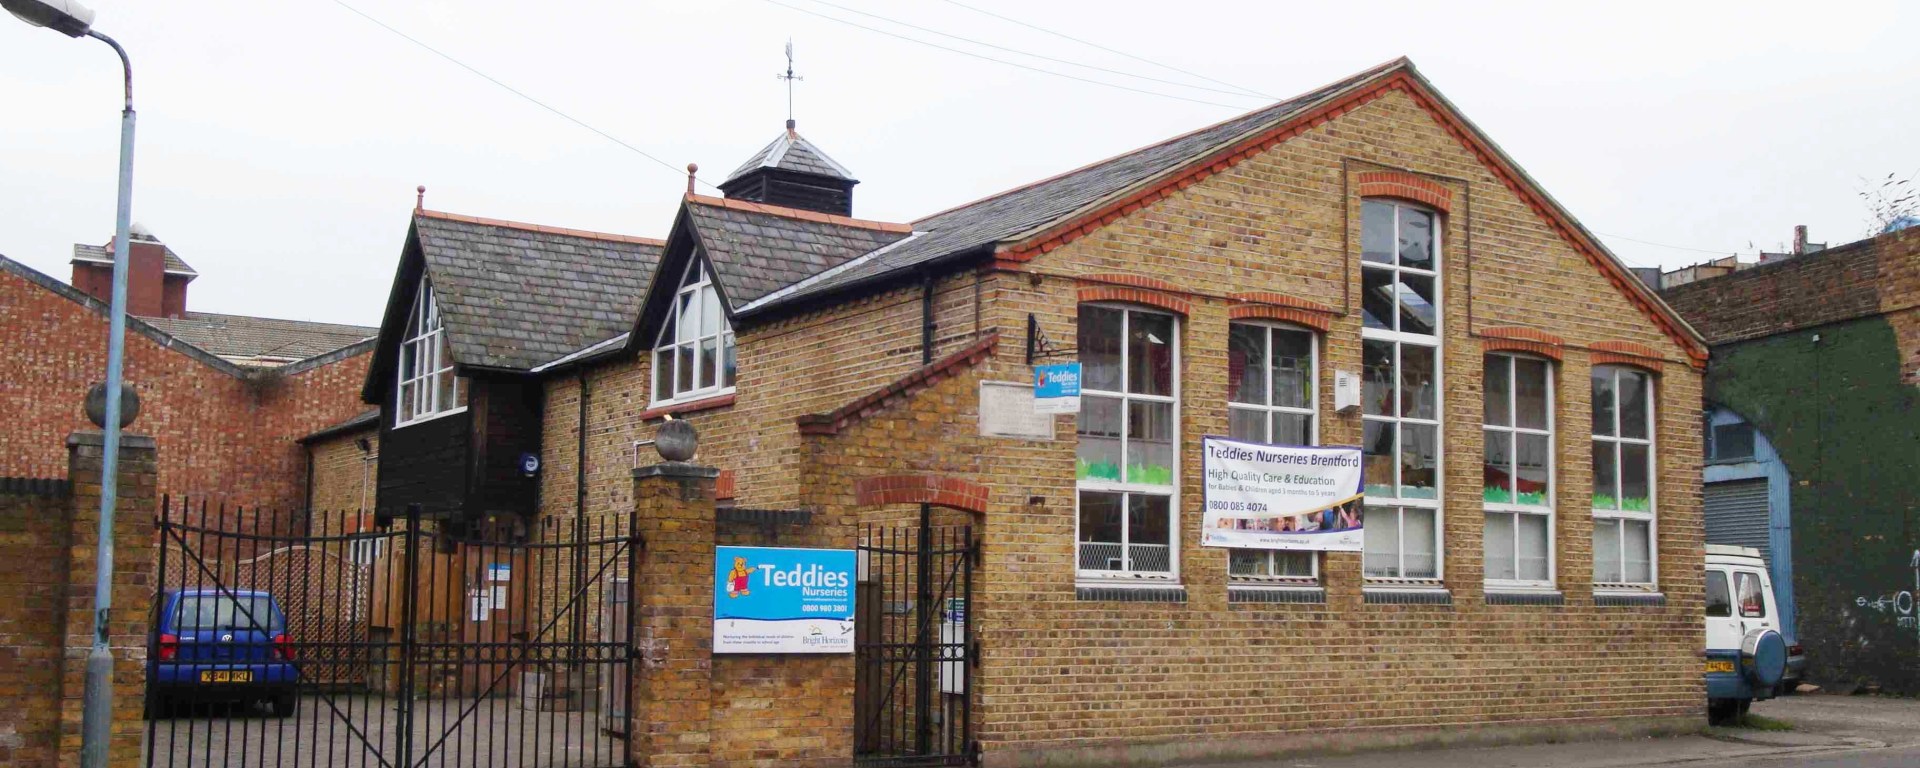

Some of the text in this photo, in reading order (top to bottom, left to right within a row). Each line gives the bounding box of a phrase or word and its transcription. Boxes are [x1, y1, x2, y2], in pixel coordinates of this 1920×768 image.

[1048, 371, 1077, 383] Teddies
[1208, 446, 1359, 467] Teddies Nurseries Brentford
[1208, 469, 1336, 486] High Quality Care & Education
[1268, 487, 1281, 495] aged
[1209, 501, 1268, 512] 0800 085 4074
[758, 564, 848, 587] Teddies
[802, 587, 848, 597] Nurseries
[802, 604, 848, 612] 0800 980 3801
[802, 636, 848, 646] Bright Horizons
